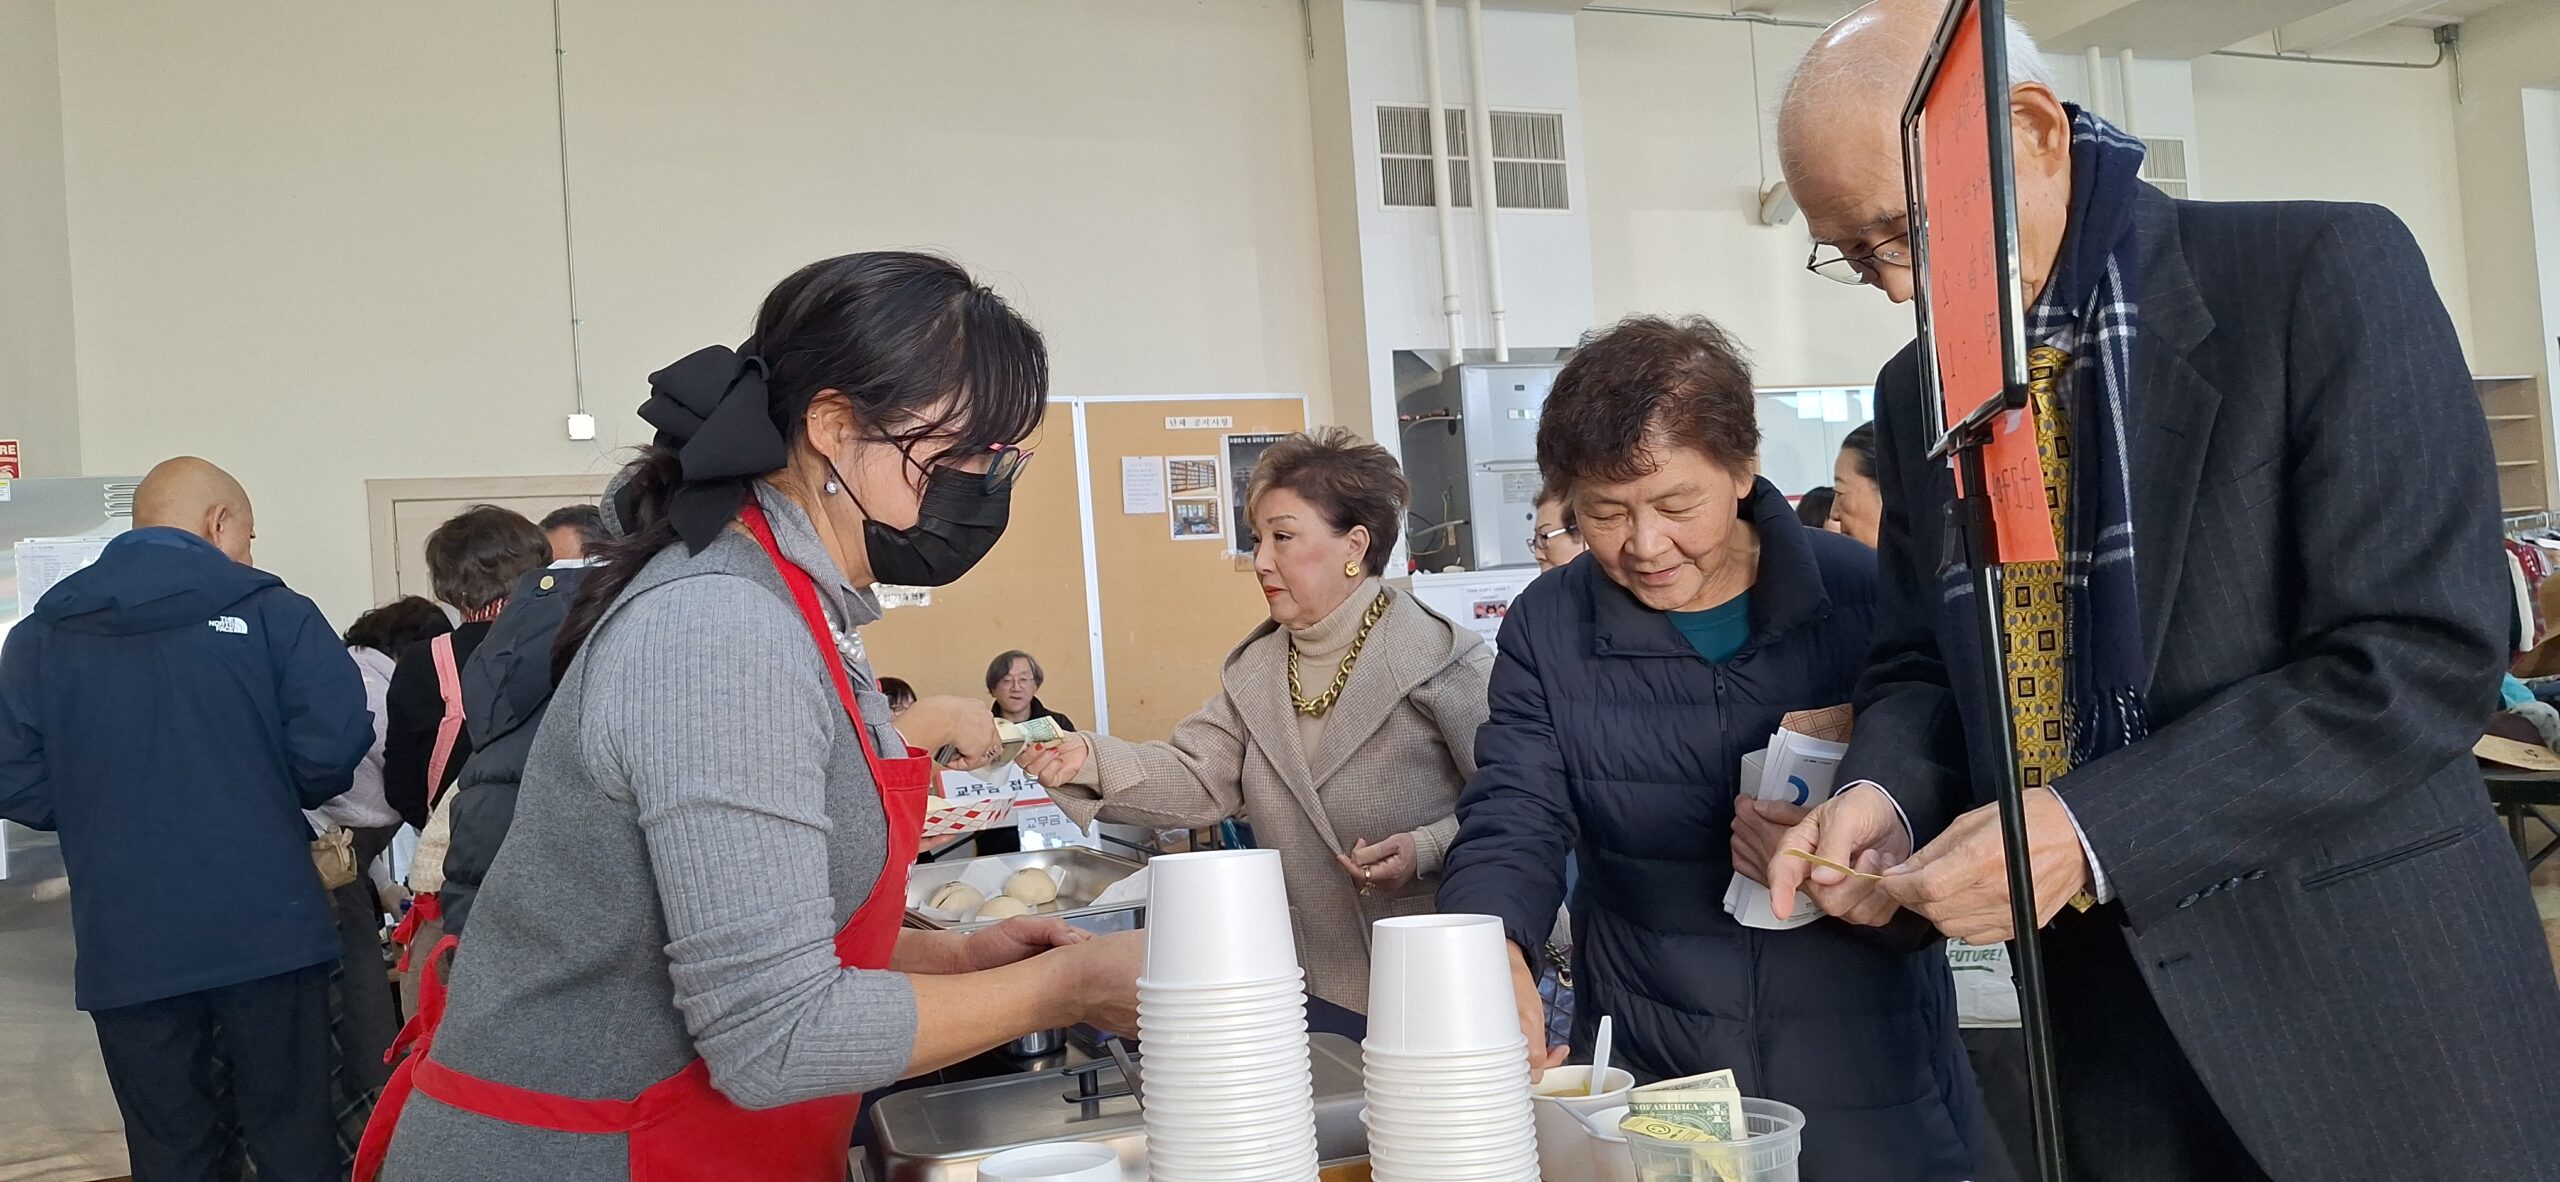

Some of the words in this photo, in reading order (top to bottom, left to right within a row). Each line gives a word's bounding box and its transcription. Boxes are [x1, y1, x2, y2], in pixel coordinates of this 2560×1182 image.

[955, 783, 1000, 797] 교무금
[1026, 813, 1060, 829] 교무금
[1949, 948, 2003, 962] FUTURE!
[1652, 1103, 1699, 1111] AMERICA
